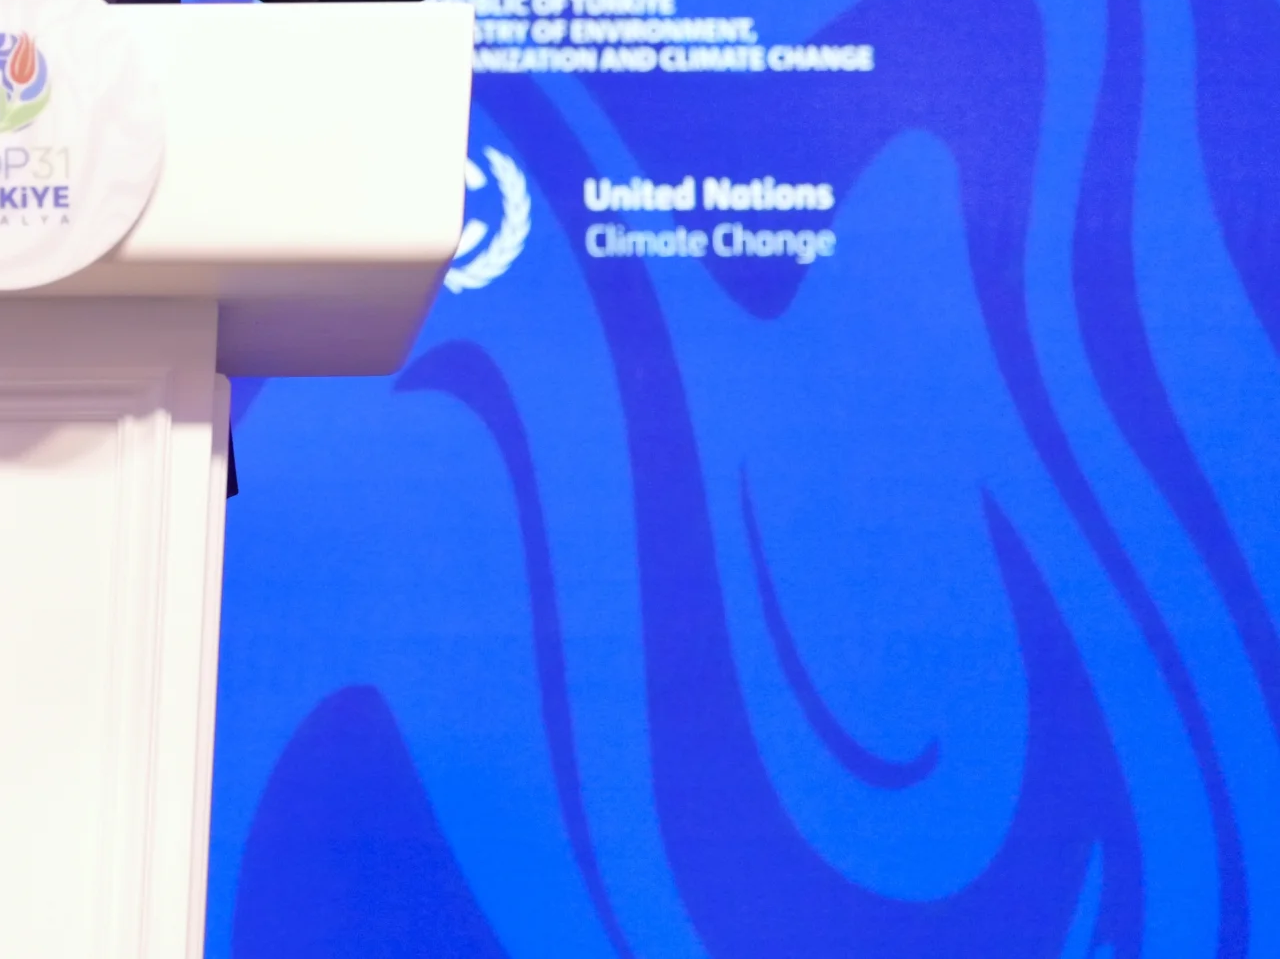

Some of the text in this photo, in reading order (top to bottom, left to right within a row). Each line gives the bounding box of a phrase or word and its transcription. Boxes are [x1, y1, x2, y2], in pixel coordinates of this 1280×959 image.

[530, 18, 568, 45] OF
[599, 45, 658, 73] AND
[658, 45, 766, 73] CLIMATE
[767, 45, 875, 72] CHANGE
[583, 175, 835, 211] United Nations
[585, 222, 837, 265] Climate Change
